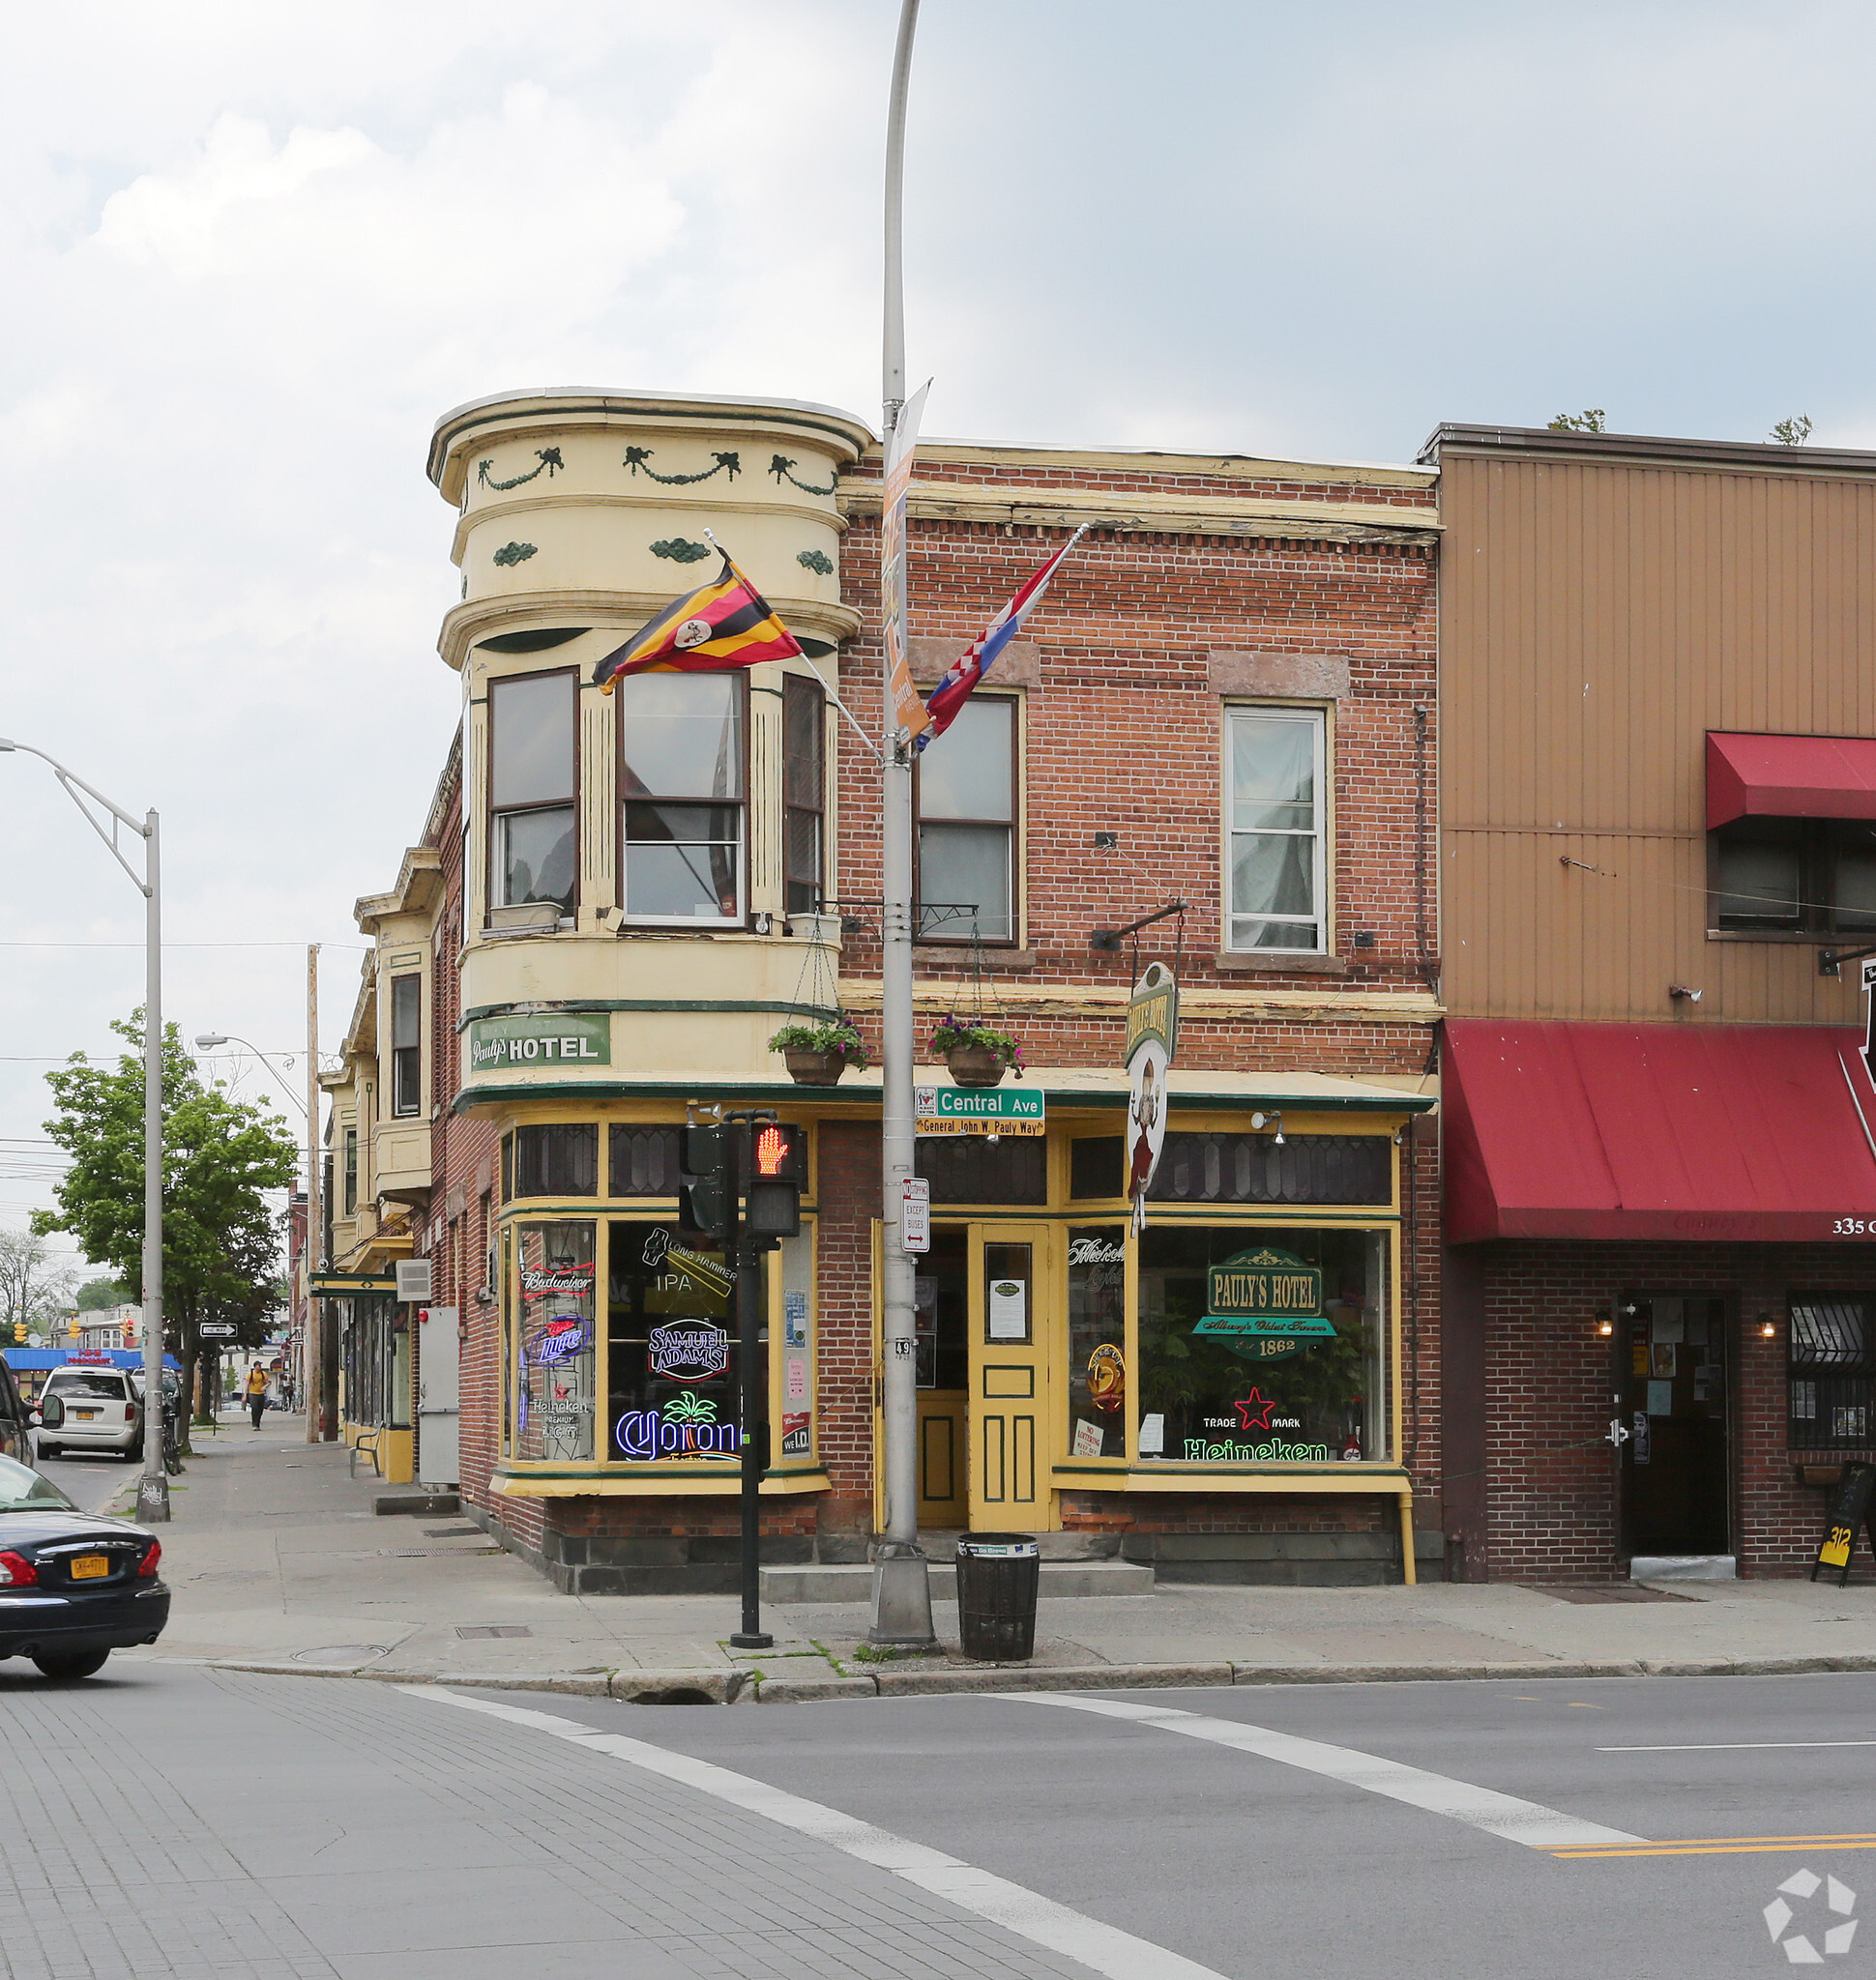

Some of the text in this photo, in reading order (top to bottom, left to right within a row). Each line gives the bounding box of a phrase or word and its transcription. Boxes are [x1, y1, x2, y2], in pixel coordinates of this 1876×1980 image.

[473, 1037, 599, 1066] Pauly's HOTEL
[941, 1092, 1038, 1113] Central Ave
[923, 1120, 1037, 1136] General John W. Pauly Way
[906, 1205, 924, 1215] EXCEPT
[907, 1219, 923, 1229] BUSES
[1832, 1218, 1864, 1235] 335
[668, 1240, 738, 1282] LONG HAMMER
[520, 1271, 594, 1289] Budweiser
[657, 1274, 691, 1292] IPA
[1214, 1274, 1316, 1308] PAULY'S HOTEL
[1203, 1320, 1252, 1333] Albany's
[1254, 1320, 1286, 1331] Oldest
[539, 1330, 582, 1362] Lite
[649, 1327, 729, 1352] SAMUEL
[896, 1342, 909, 1354] 49
[1259, 1340, 1296, 1356] 1862
[656, 1348, 722, 1374] ADAMS
[533, 1399, 588, 1413] Heineken
[1087, 1425, 1094, 1435] NO
[1203, 1418, 1301, 1428] TRADE MARK
[616, 1411, 744, 1461] Coron
[784, 1431, 808, 1450] WE I.D.
[1077, 1430, 1100, 1447] LOITERING
[1184, 1437, 1329, 1461] Heineken
[1832, 1527, 1851, 1549] 312
